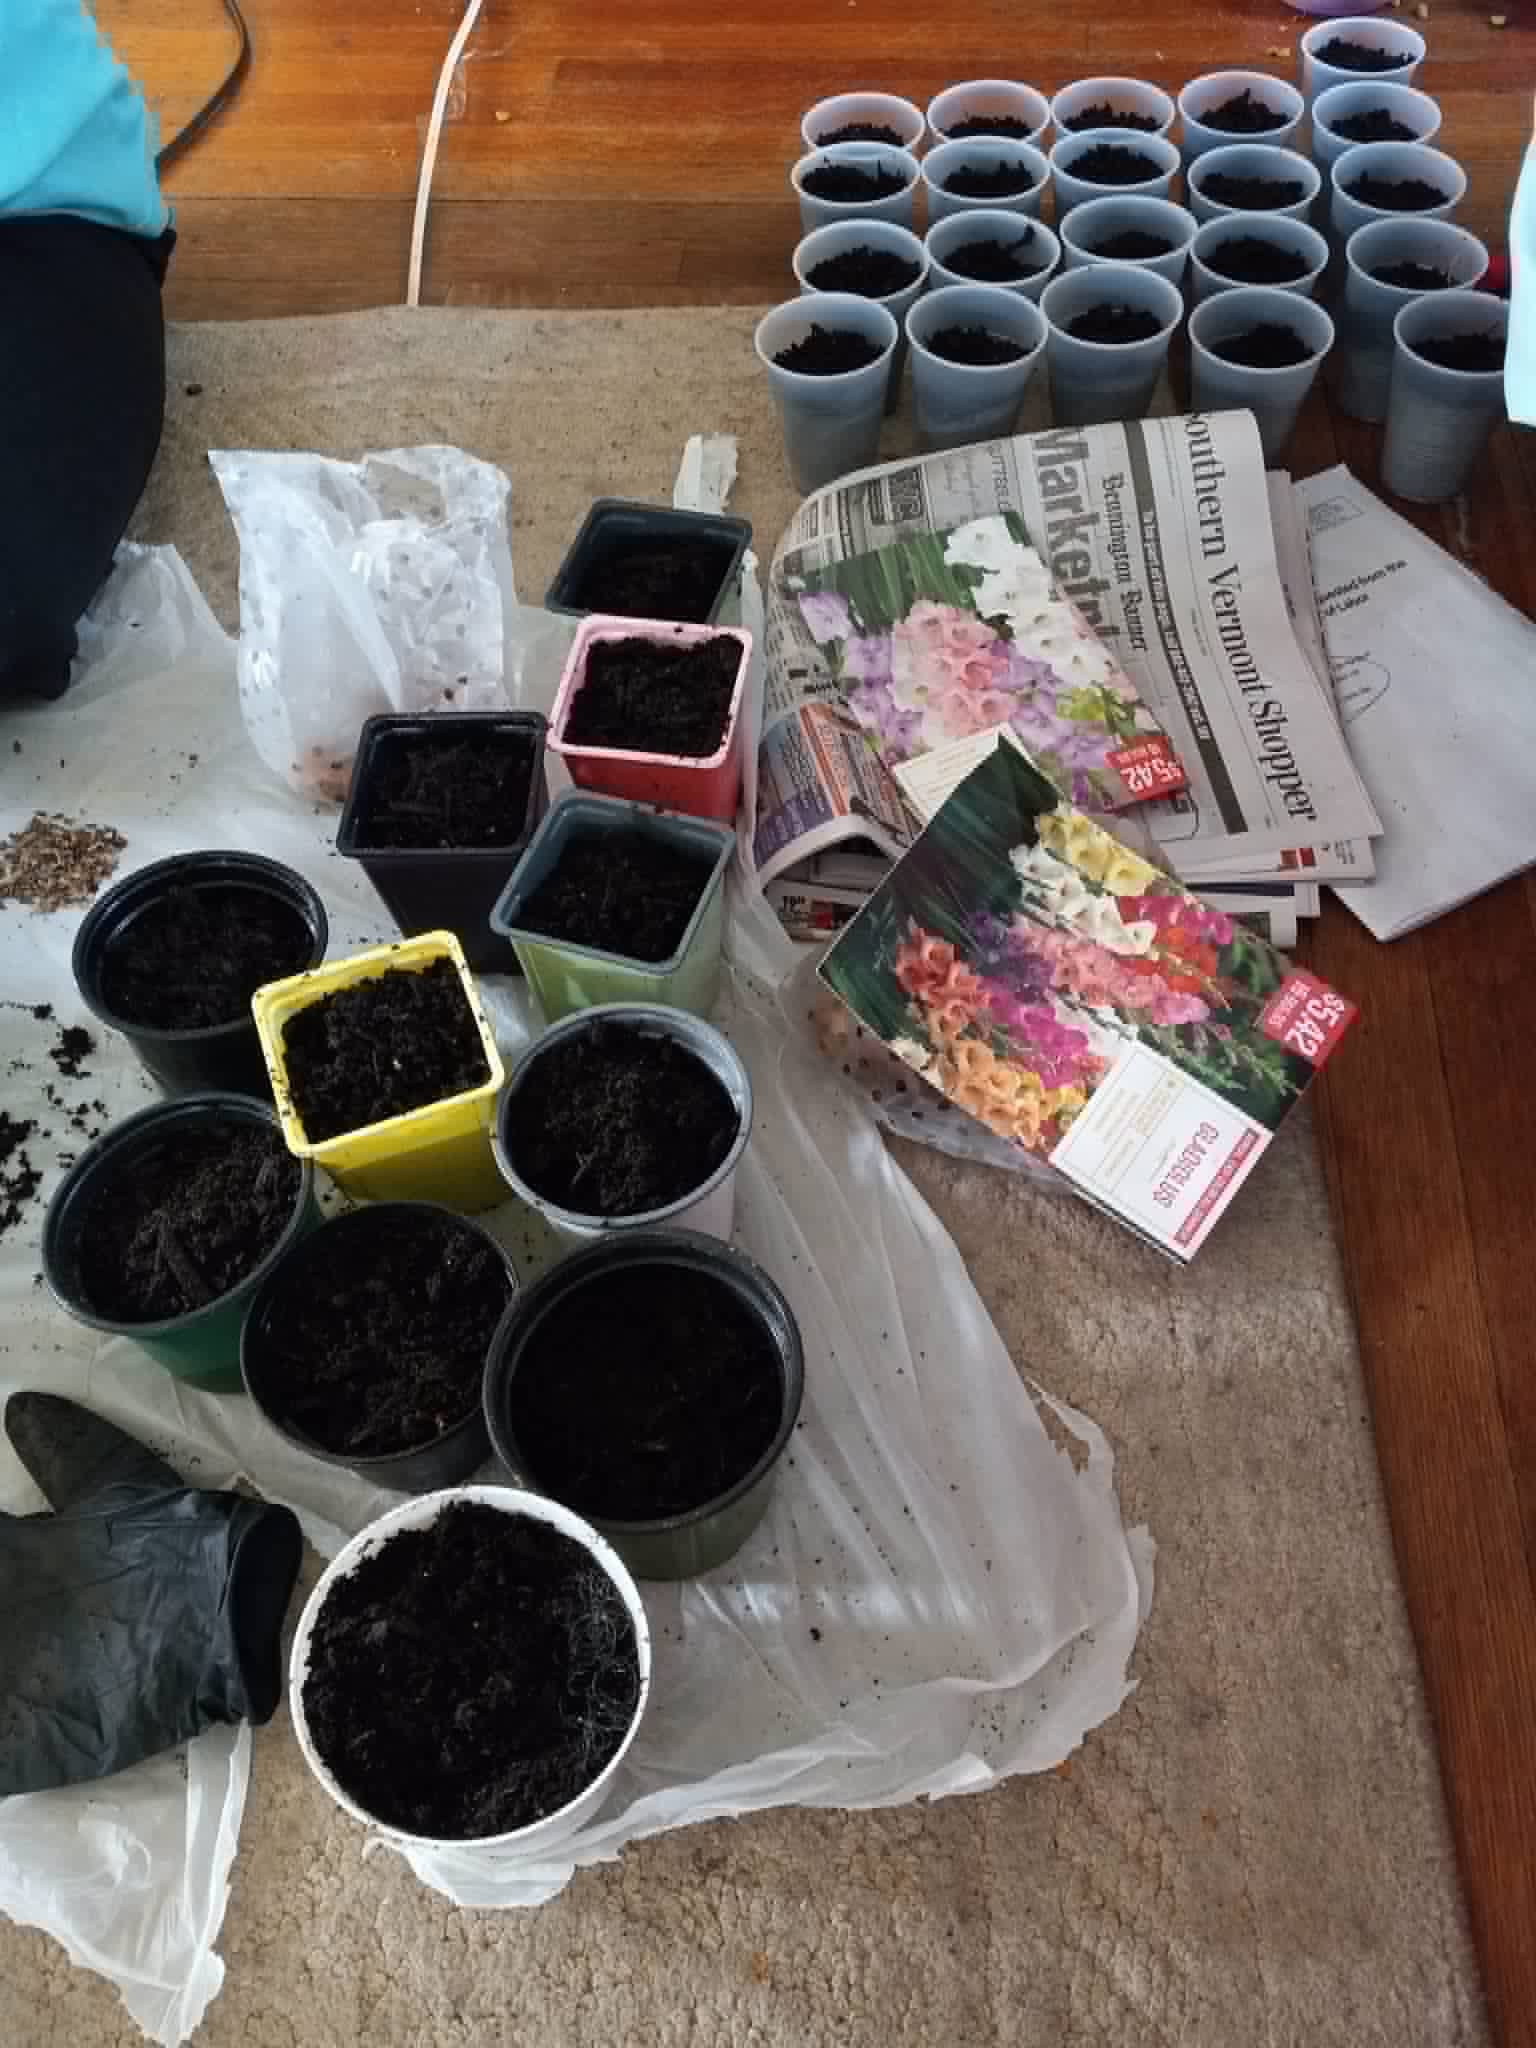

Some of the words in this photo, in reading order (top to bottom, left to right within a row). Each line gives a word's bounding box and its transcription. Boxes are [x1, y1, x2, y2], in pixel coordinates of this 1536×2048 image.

[1101, 471, 1133, 584] Bennington
[1121, 588, 1147, 652] Banner
[1207, 563, 1272, 696] Vermont
[1248, 700, 1317, 821] Shopper
[1285, 990, 1345, 1056] $5.42
